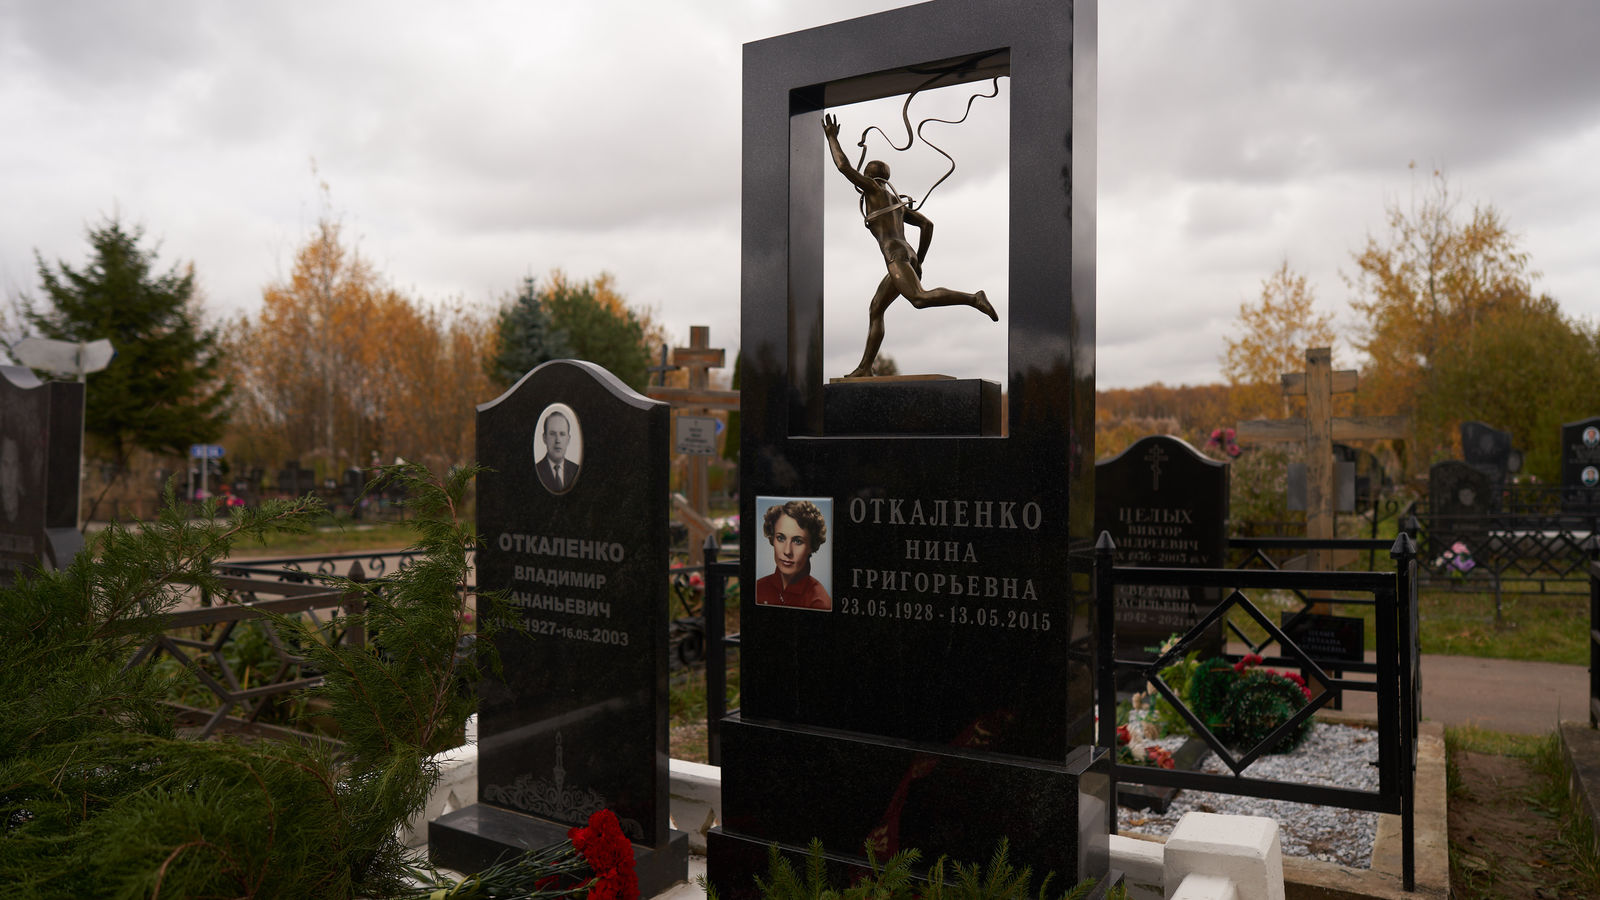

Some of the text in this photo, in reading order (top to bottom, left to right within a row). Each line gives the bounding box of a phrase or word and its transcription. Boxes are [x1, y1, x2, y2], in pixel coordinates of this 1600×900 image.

[850, 498, 1042, 530] ОТКАЛЕНКО
[1128, 525, 1183, 537] ВИКТОР
[499, 532, 625, 563] ОТКАЛЕНКО
[905, 539, 978, 563] НИНА
[514, 565, 607, 590] ВЛАДИМИР
[852, 568, 1038, 600] ГРИГОРЬЕВНА
[510, 591, 611, 618] АНАНЬЕВИЧ
[841, 597, 934, 621] 23.05.1928
[950, 605, 1051, 631] 13.05.2015
